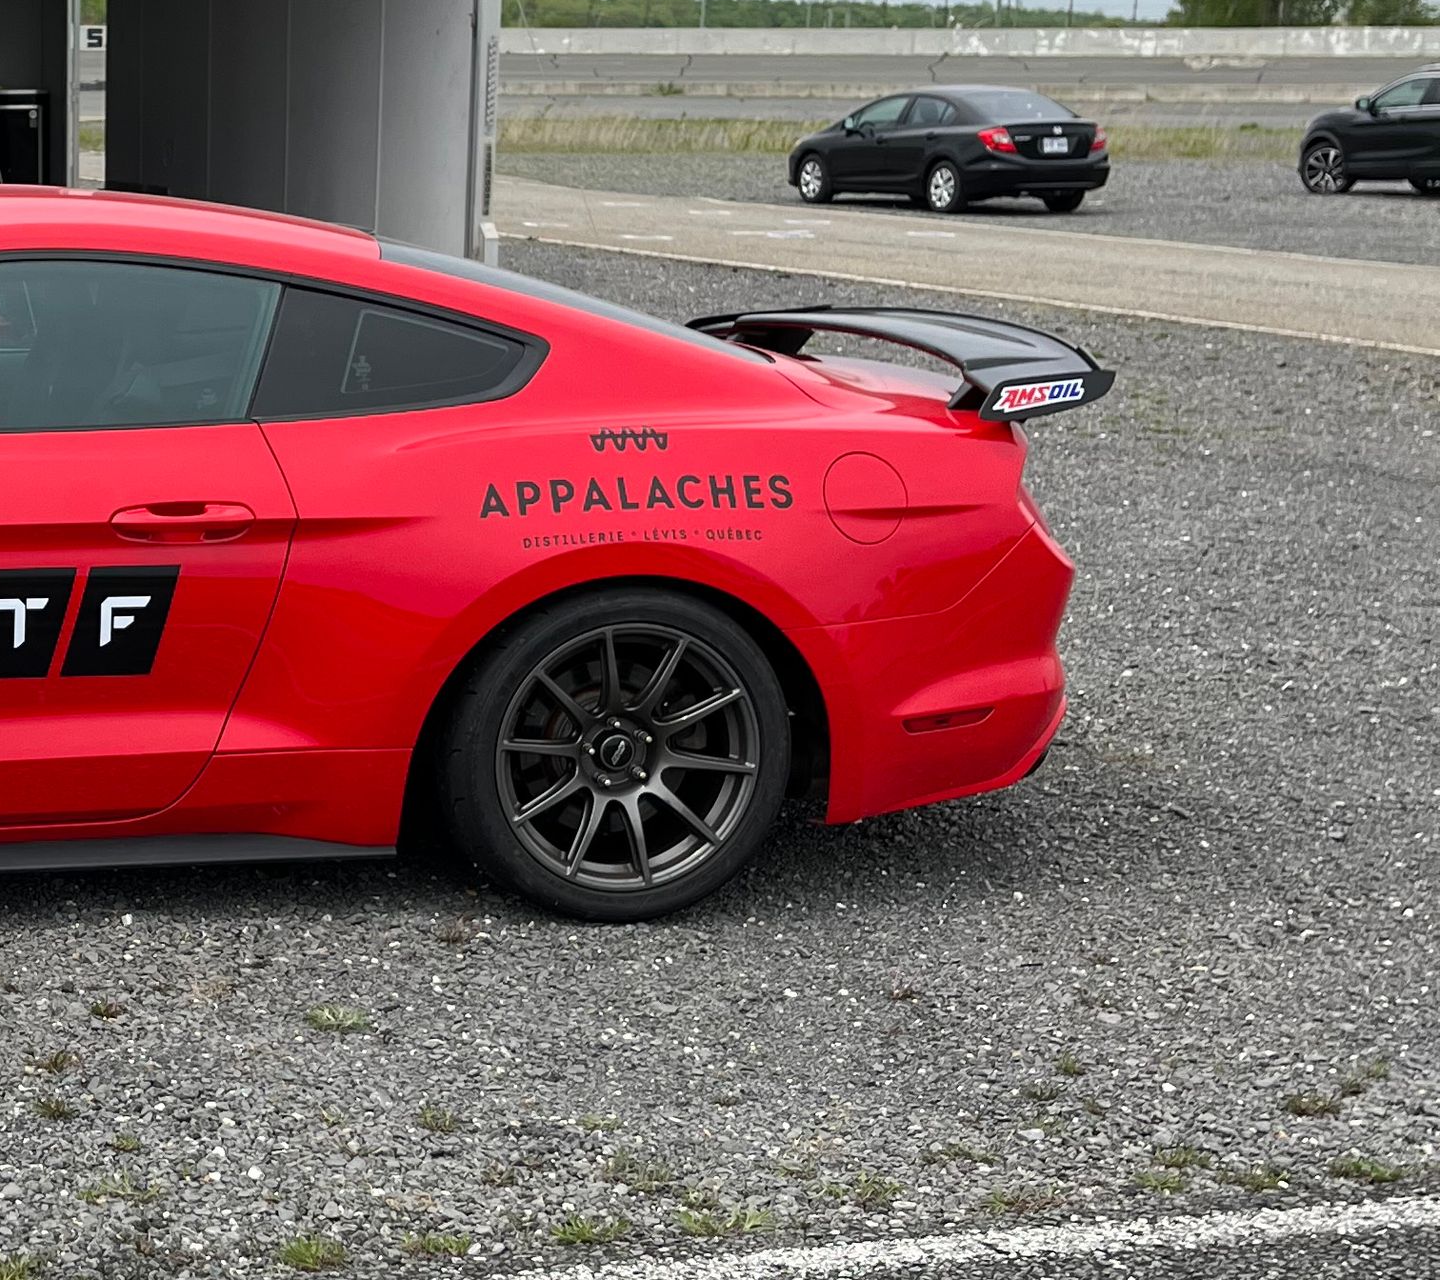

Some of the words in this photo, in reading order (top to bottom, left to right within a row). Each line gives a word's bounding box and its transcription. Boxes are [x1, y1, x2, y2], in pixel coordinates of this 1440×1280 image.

[1000, 382, 1081, 409] AMSOIL
[480, 474, 794, 519] APPALACHES
[522, 530, 624, 549] DISTILLERIE
[643, 527, 688, 541] LÉVIS
[706, 526, 763, 541] QUÉBEC
